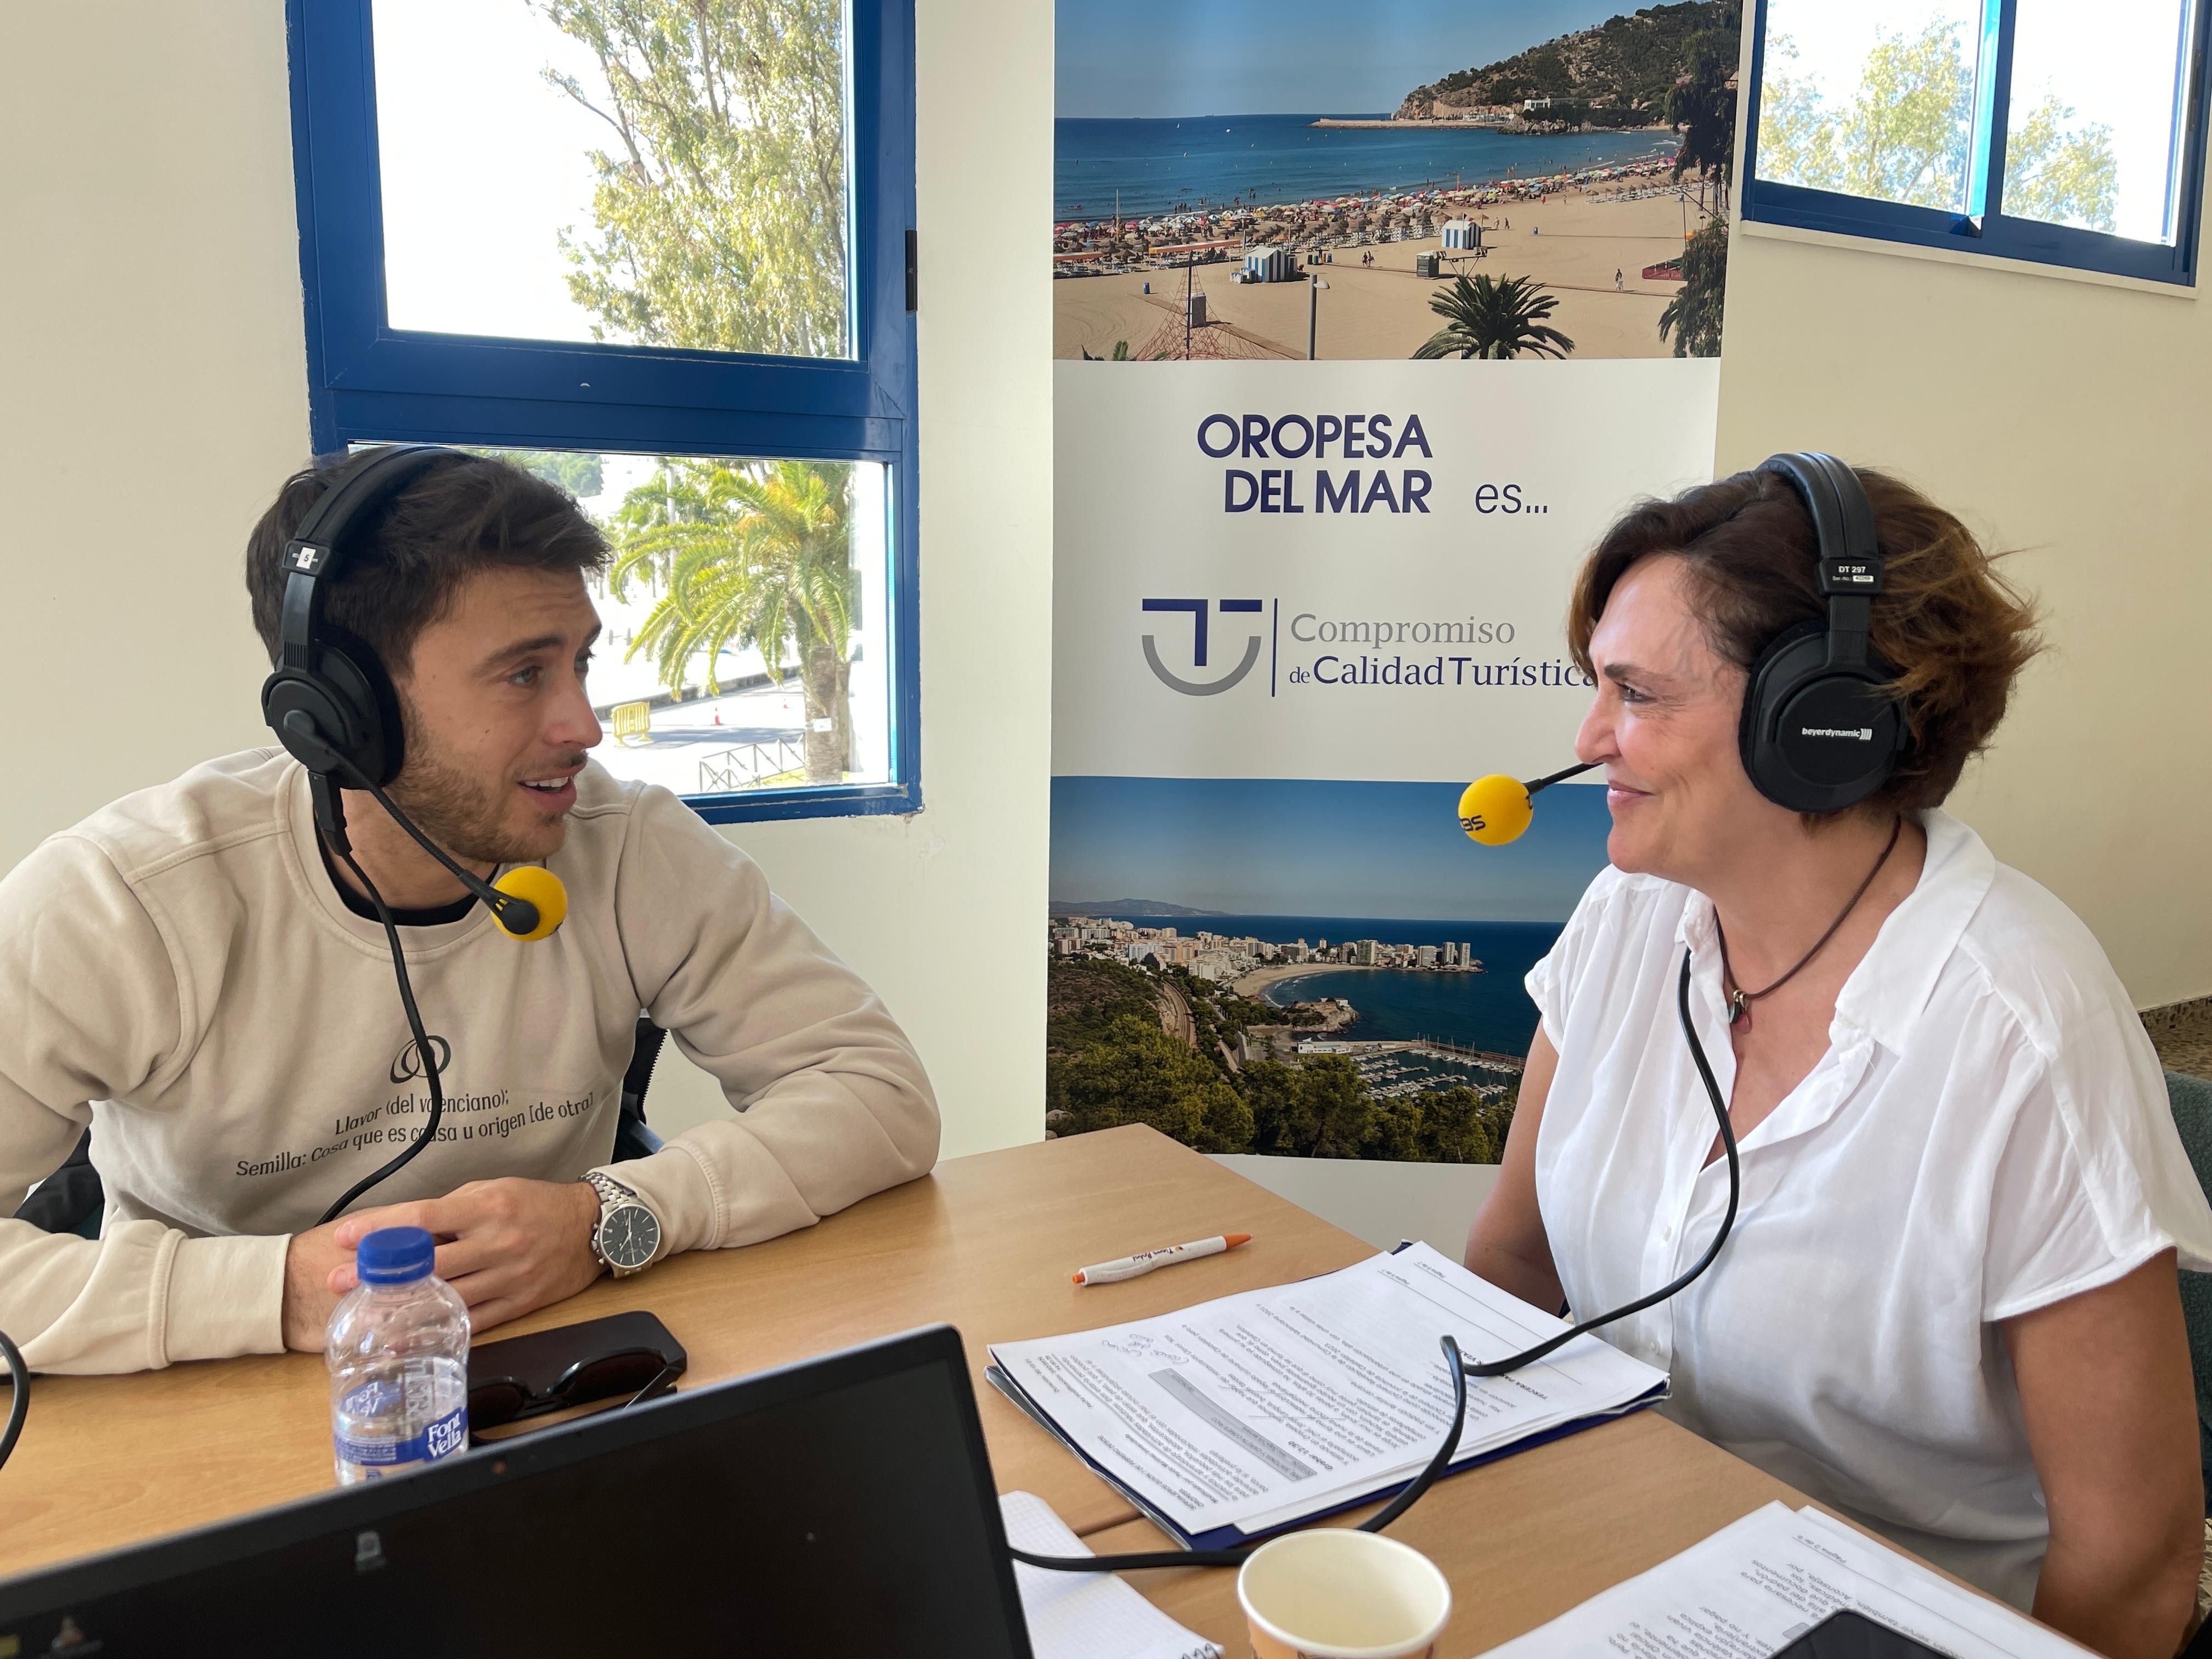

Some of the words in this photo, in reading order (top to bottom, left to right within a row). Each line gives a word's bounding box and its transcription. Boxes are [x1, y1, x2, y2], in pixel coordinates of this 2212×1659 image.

[1198, 414, 1433, 458] OROPESA
[1224, 469, 1304, 513] DEL
[1316, 470, 1433, 513] MAR
[1475, 483, 1548, 514] es...
[1290, 613, 1515, 649] Compromiso
[1290, 666, 1310, 684] de
[1313, 656, 1443, 686] Calidad
[1802, 727, 1860, 738] beyerdynamic
[1460, 815, 1486, 832] SE
[335, 1104, 382, 1136] Llavor
[386, 1093, 414, 1115] (del
[420, 1089, 509, 1113] vaenciano);
[235, 1152, 307, 1176] Semilla:
[311, 1138, 348, 1163] Cosa
[353, 1127, 383, 1151] que
[388, 1128, 406, 1142] es
[411, 1126, 457, 1142] csa
[463, 1126, 473, 1139] u
[478, 1113, 526, 1138] origen
[529, 1102, 554, 1123] [de
[558, 1092, 593, 1118] otra]
[428, 1413, 461, 1442] Font
[1420, 1408, 1457, 1428] econocido
[428, 1429, 461, 1459] Vella
